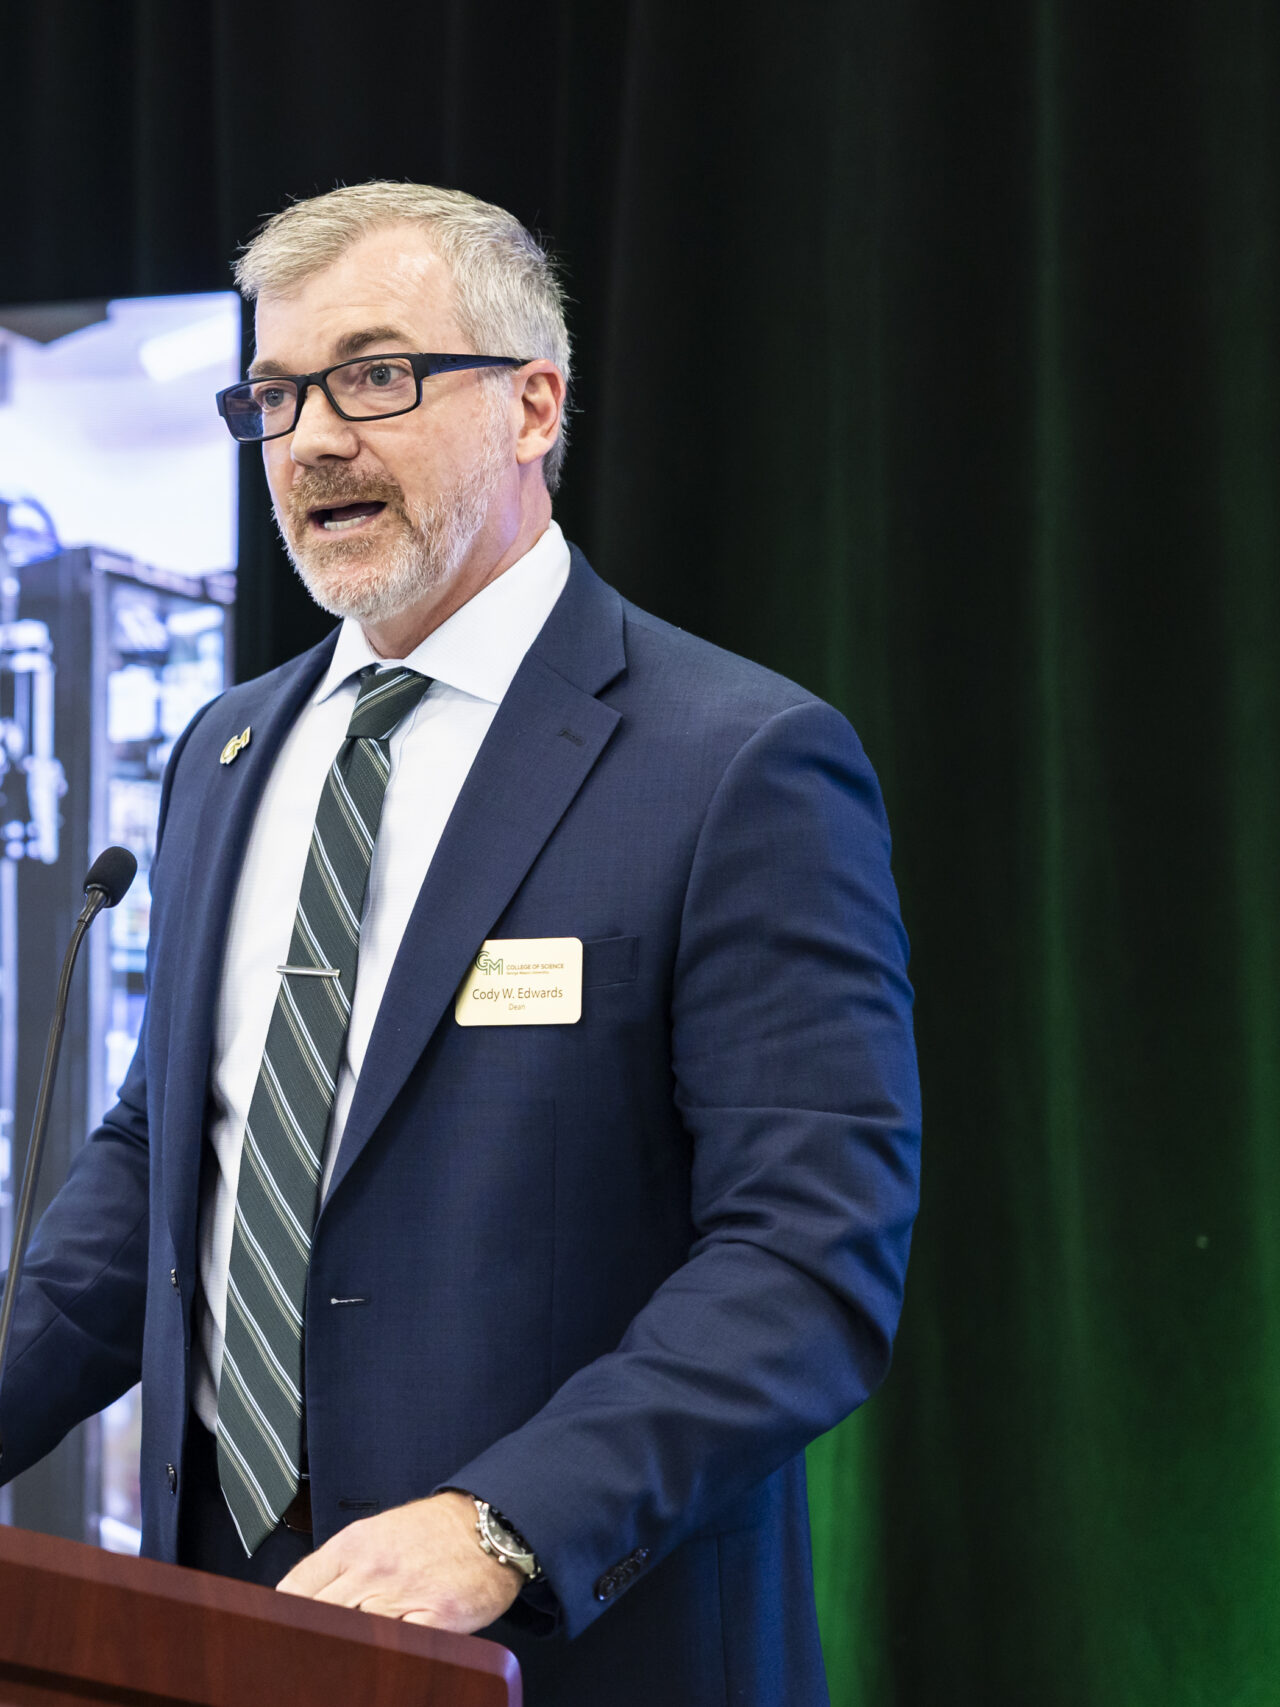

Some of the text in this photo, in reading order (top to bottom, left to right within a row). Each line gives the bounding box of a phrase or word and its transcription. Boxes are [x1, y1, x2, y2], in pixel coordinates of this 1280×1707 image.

[472, 985, 563, 1002] Cody W. Edwards
[508, 1002, 526, 1011] Dean
